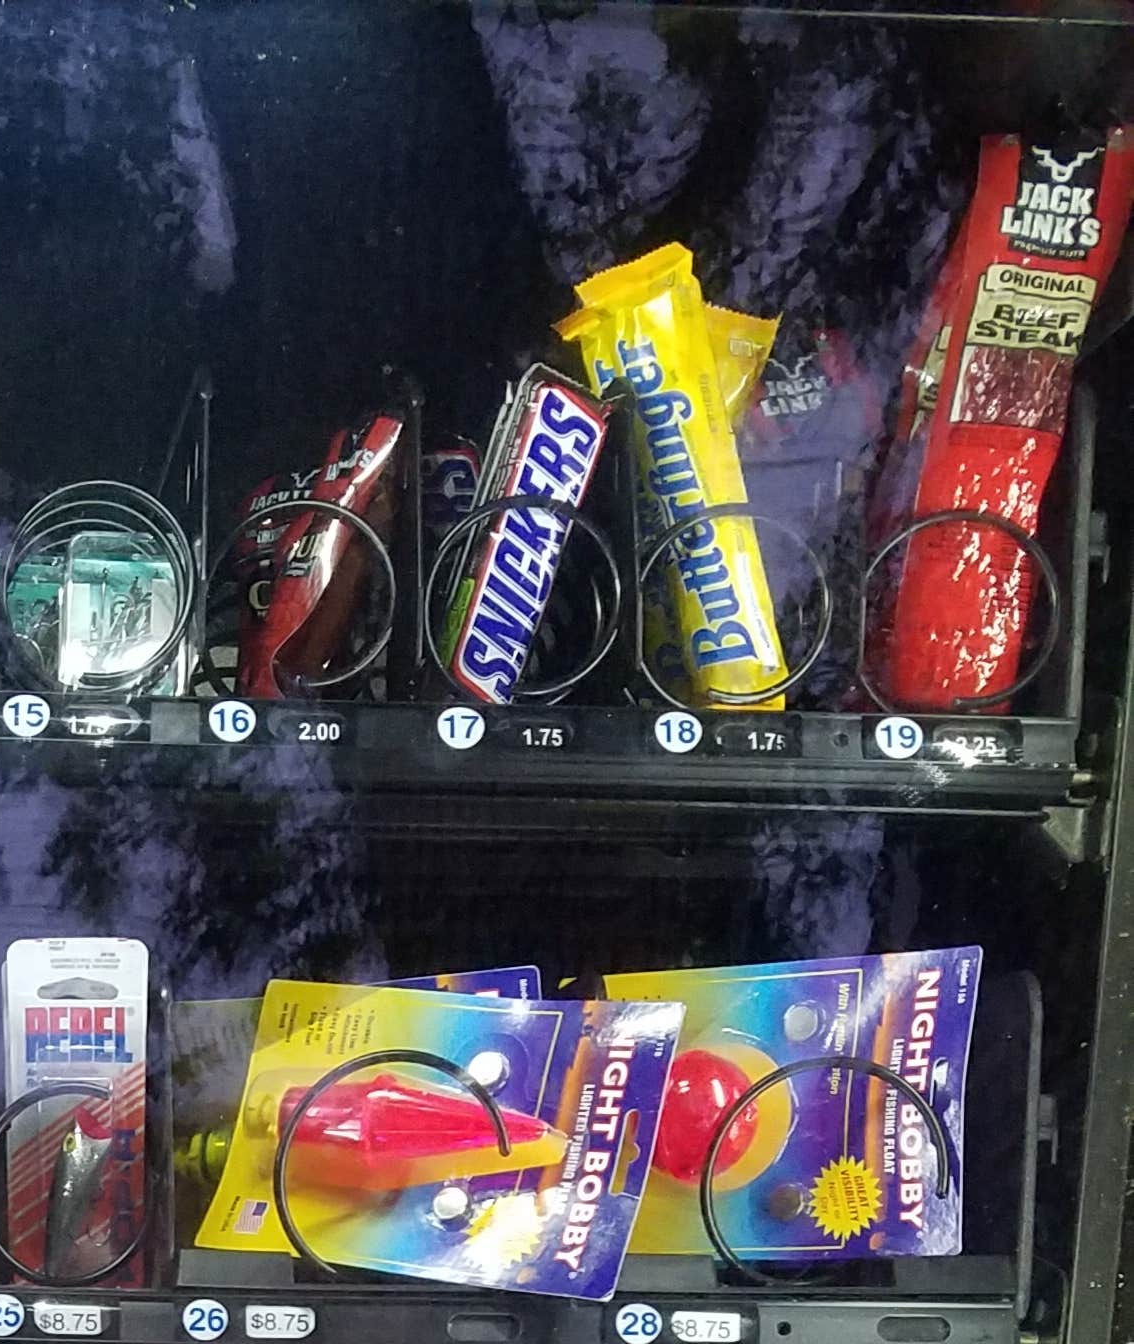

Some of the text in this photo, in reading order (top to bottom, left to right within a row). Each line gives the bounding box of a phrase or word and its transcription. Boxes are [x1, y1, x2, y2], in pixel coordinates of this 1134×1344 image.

[1017, 182, 1095, 215] JACK
[1001, 206, 1101, 247] LINK'S
[999, 270, 1086, 293] ORIGINAL
[994, 304, 1080, 328] BEEF
[975, 320, 1083, 348] STEAK
[616, 339, 760, 667] Butterfinger
[462, 388, 599, 704] SNICKERS
[8, 703, 43, 727] 15
[214, 708, 340, 740] 16 2.00
[443, 715, 563, 746] 17 1.75
[660, 720, 785, 750] 18 1.75
[881, 726, 916, 749] 19
[25, 1007, 133, 1063] REBEL
[898, 969, 941, 1229] NIGHT BOBBY
[883, 1089, 898, 1175] FISHING FLOAT
[555, 1151, 610, 1272] BOBBY
[39, 1313, 97, 1331] $8.75
[188, 1308, 309, 1332] 26 $8.75
[622, 1312, 730, 1340] 28 $8.75
